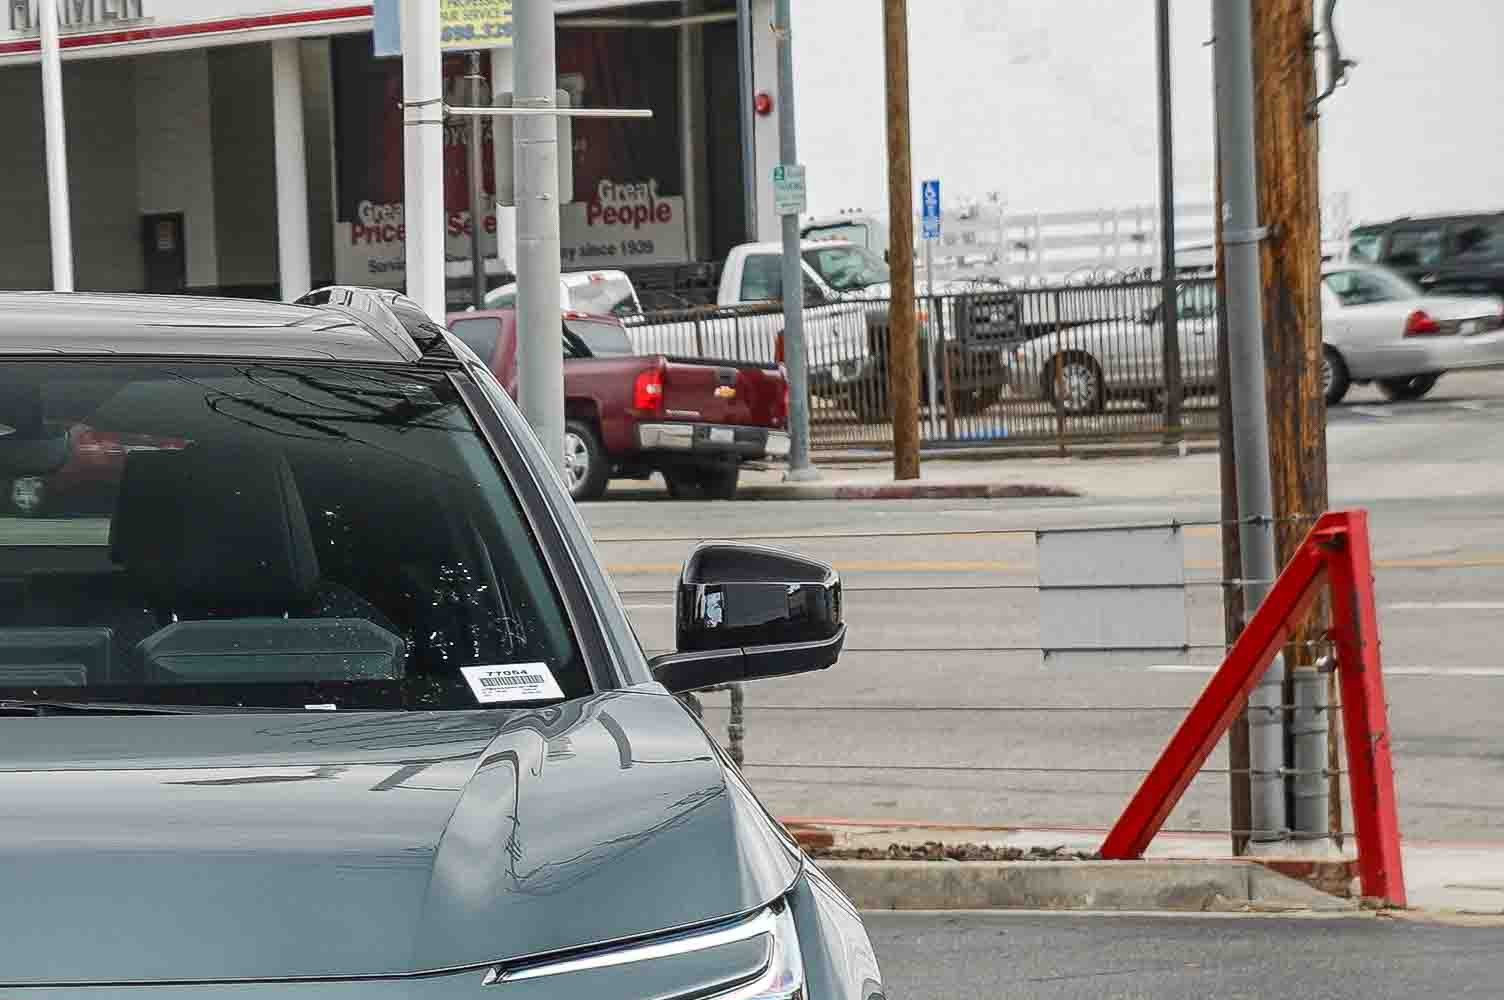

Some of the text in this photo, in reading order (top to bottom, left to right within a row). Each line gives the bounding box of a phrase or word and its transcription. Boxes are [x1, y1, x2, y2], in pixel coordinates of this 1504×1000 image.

[598, 178, 658, 204] Great
[358, 200, 405, 226] Grea
[586, 194, 672, 230] People
[352, 222, 407, 246] Price
